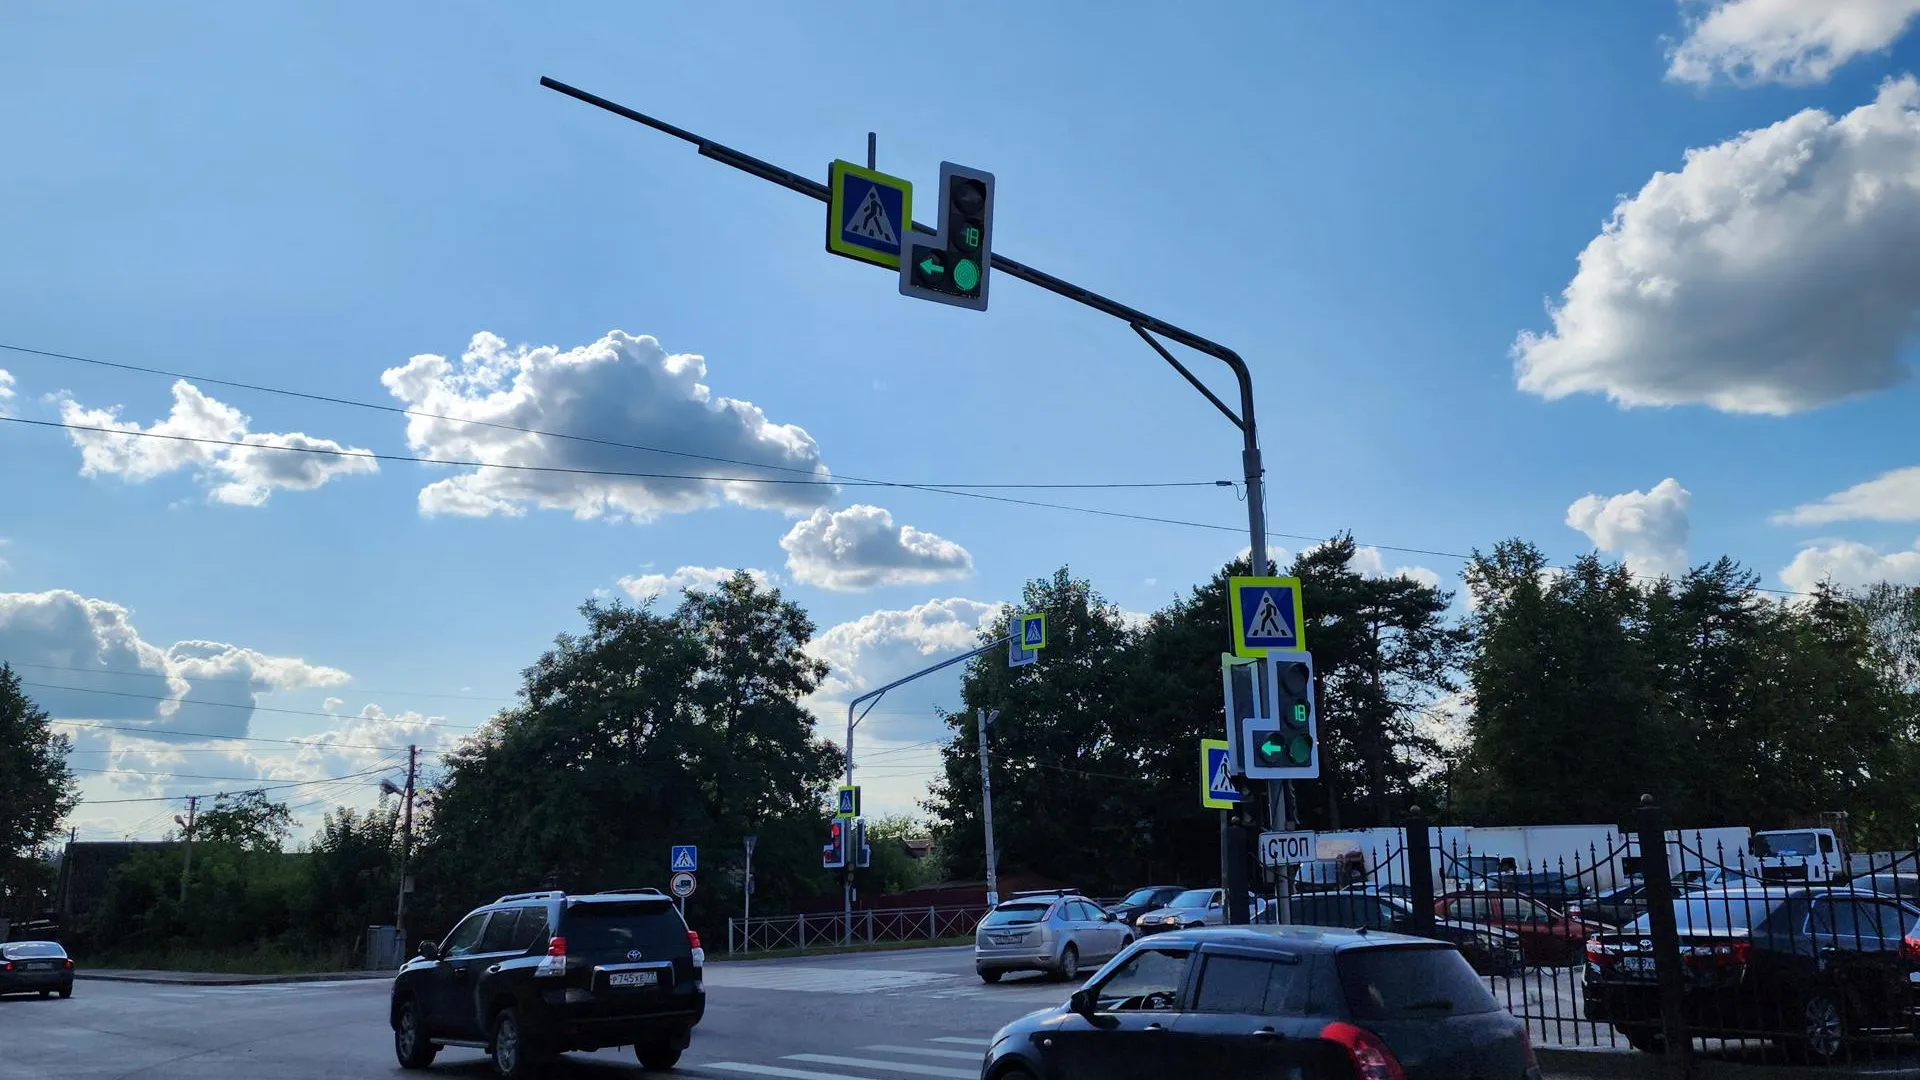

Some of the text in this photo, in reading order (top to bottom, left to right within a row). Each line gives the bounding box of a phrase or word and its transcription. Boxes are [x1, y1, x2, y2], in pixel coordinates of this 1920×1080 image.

[966, 227, 979, 247] 18
[1295, 704, 1305, 721] 18
[1268, 837, 1309, 859] СТОП
